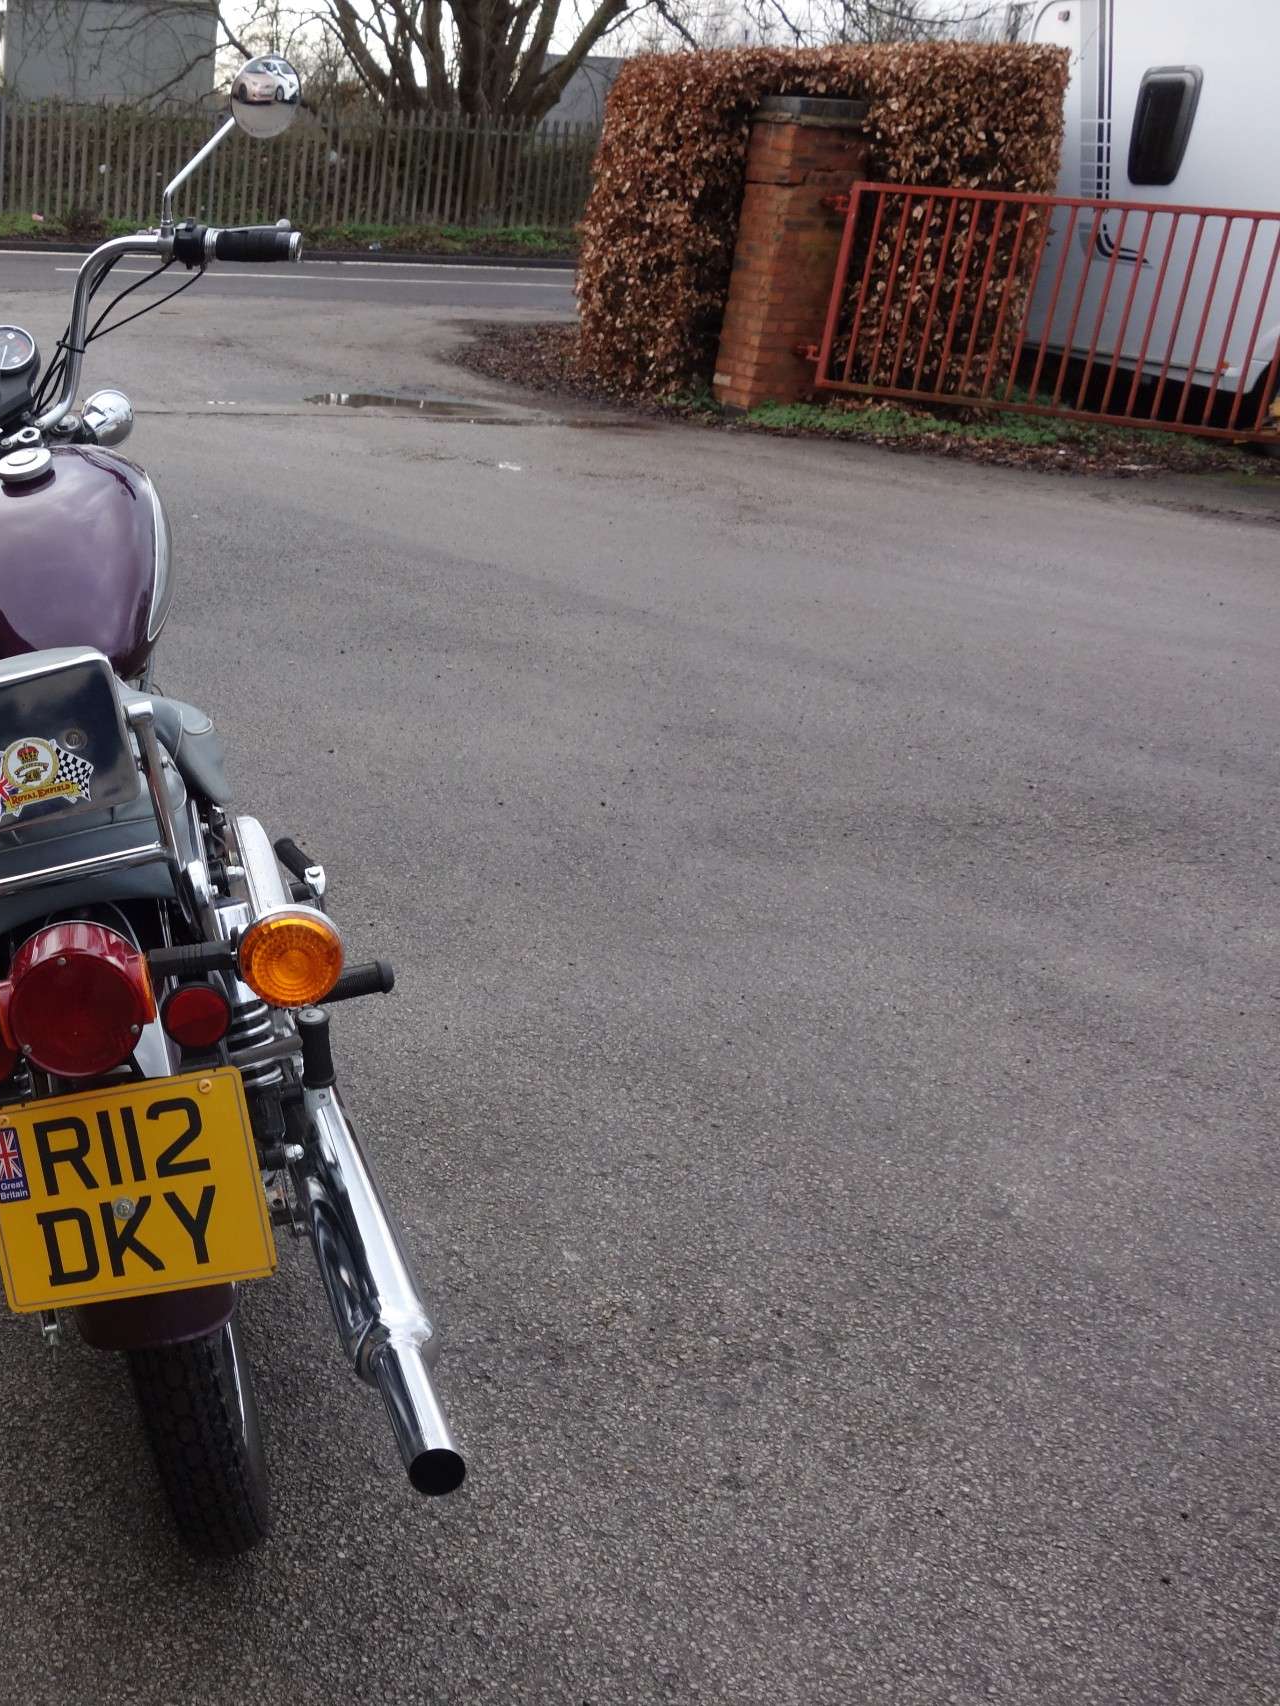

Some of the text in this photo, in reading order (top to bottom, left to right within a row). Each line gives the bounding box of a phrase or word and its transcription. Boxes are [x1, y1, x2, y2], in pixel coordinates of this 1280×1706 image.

[11, 791, 38, 805] ROYAL
[32, 1097, 211, 1197] R112
[0, 1181, 24, 1191] Great
[0, 1190, 28, 1200] Britain
[36, 1184, 216, 1287] DKY
